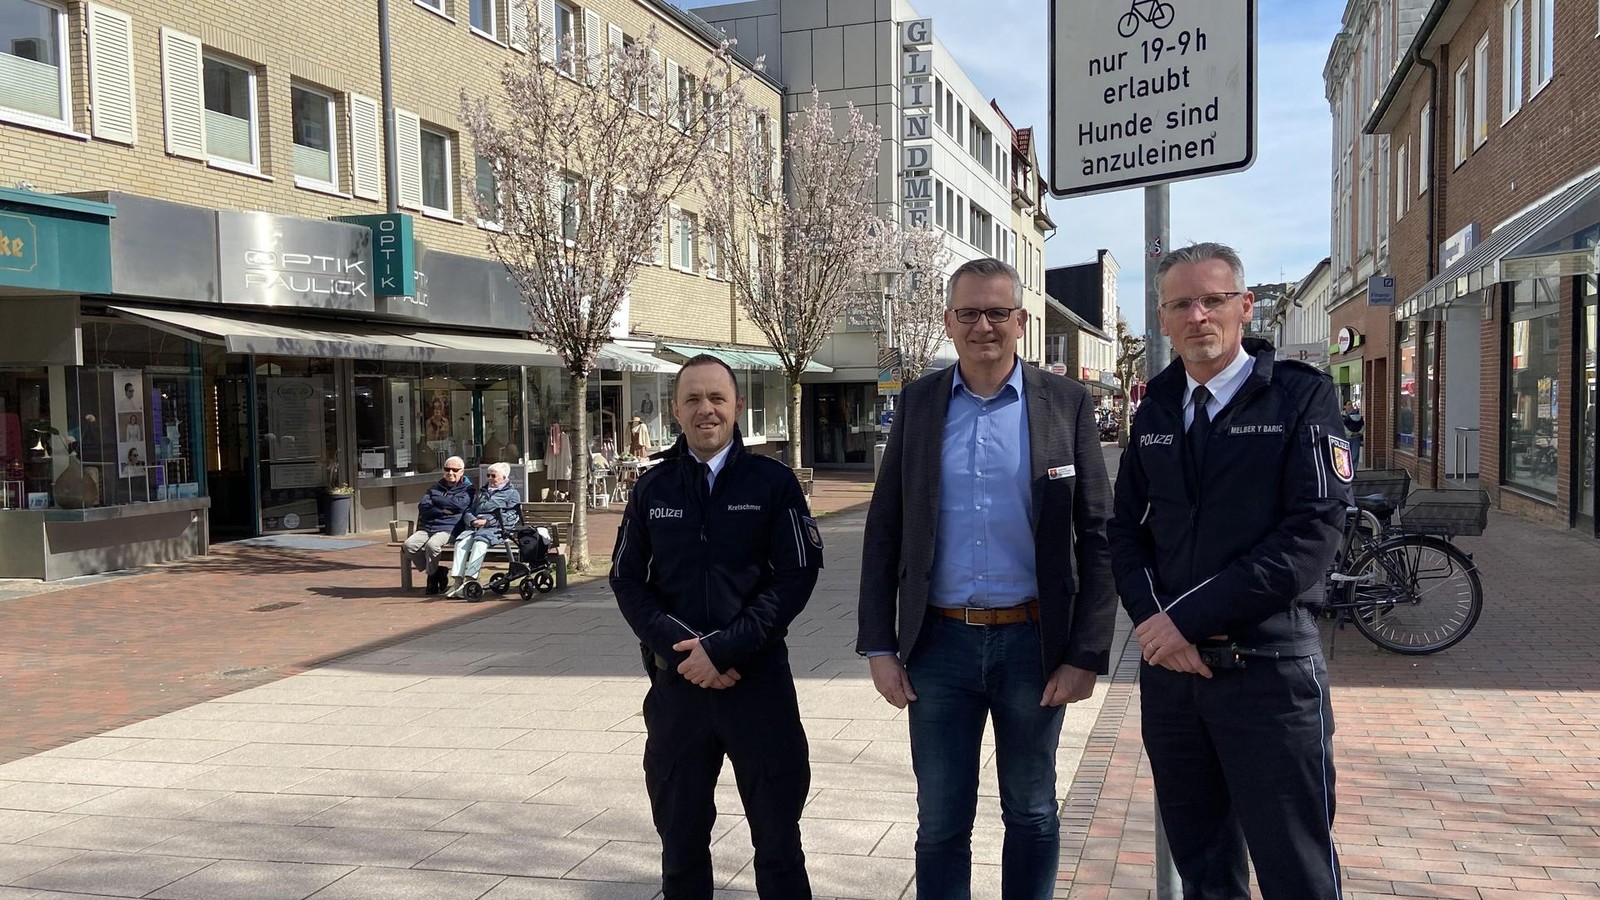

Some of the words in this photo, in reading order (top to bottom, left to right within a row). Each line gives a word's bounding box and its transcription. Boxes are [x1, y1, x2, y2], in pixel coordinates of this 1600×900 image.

[1089, 51, 1128, 76] nur
[1103, 66, 1190, 104] erlaubt
[1078, 113, 1153, 146] Hunde
[1166, 96, 1218, 130] sind
[1082, 137, 1215, 176] anzuleinen
[244, 250, 366, 276] OPTIK
[380, 220, 395, 288] OPTIK
[244, 273, 367, 297] PAULICK
[1140, 433, 1174, 448] POLIZEI
[1231, 425, 1256, 434] MELBER
[1257, 425, 1263, 433] Y
[1263, 424, 1283, 433] BARIC
[650, 508, 683, 520] POLIZEI
[728, 503, 761, 511] Kretschmer
